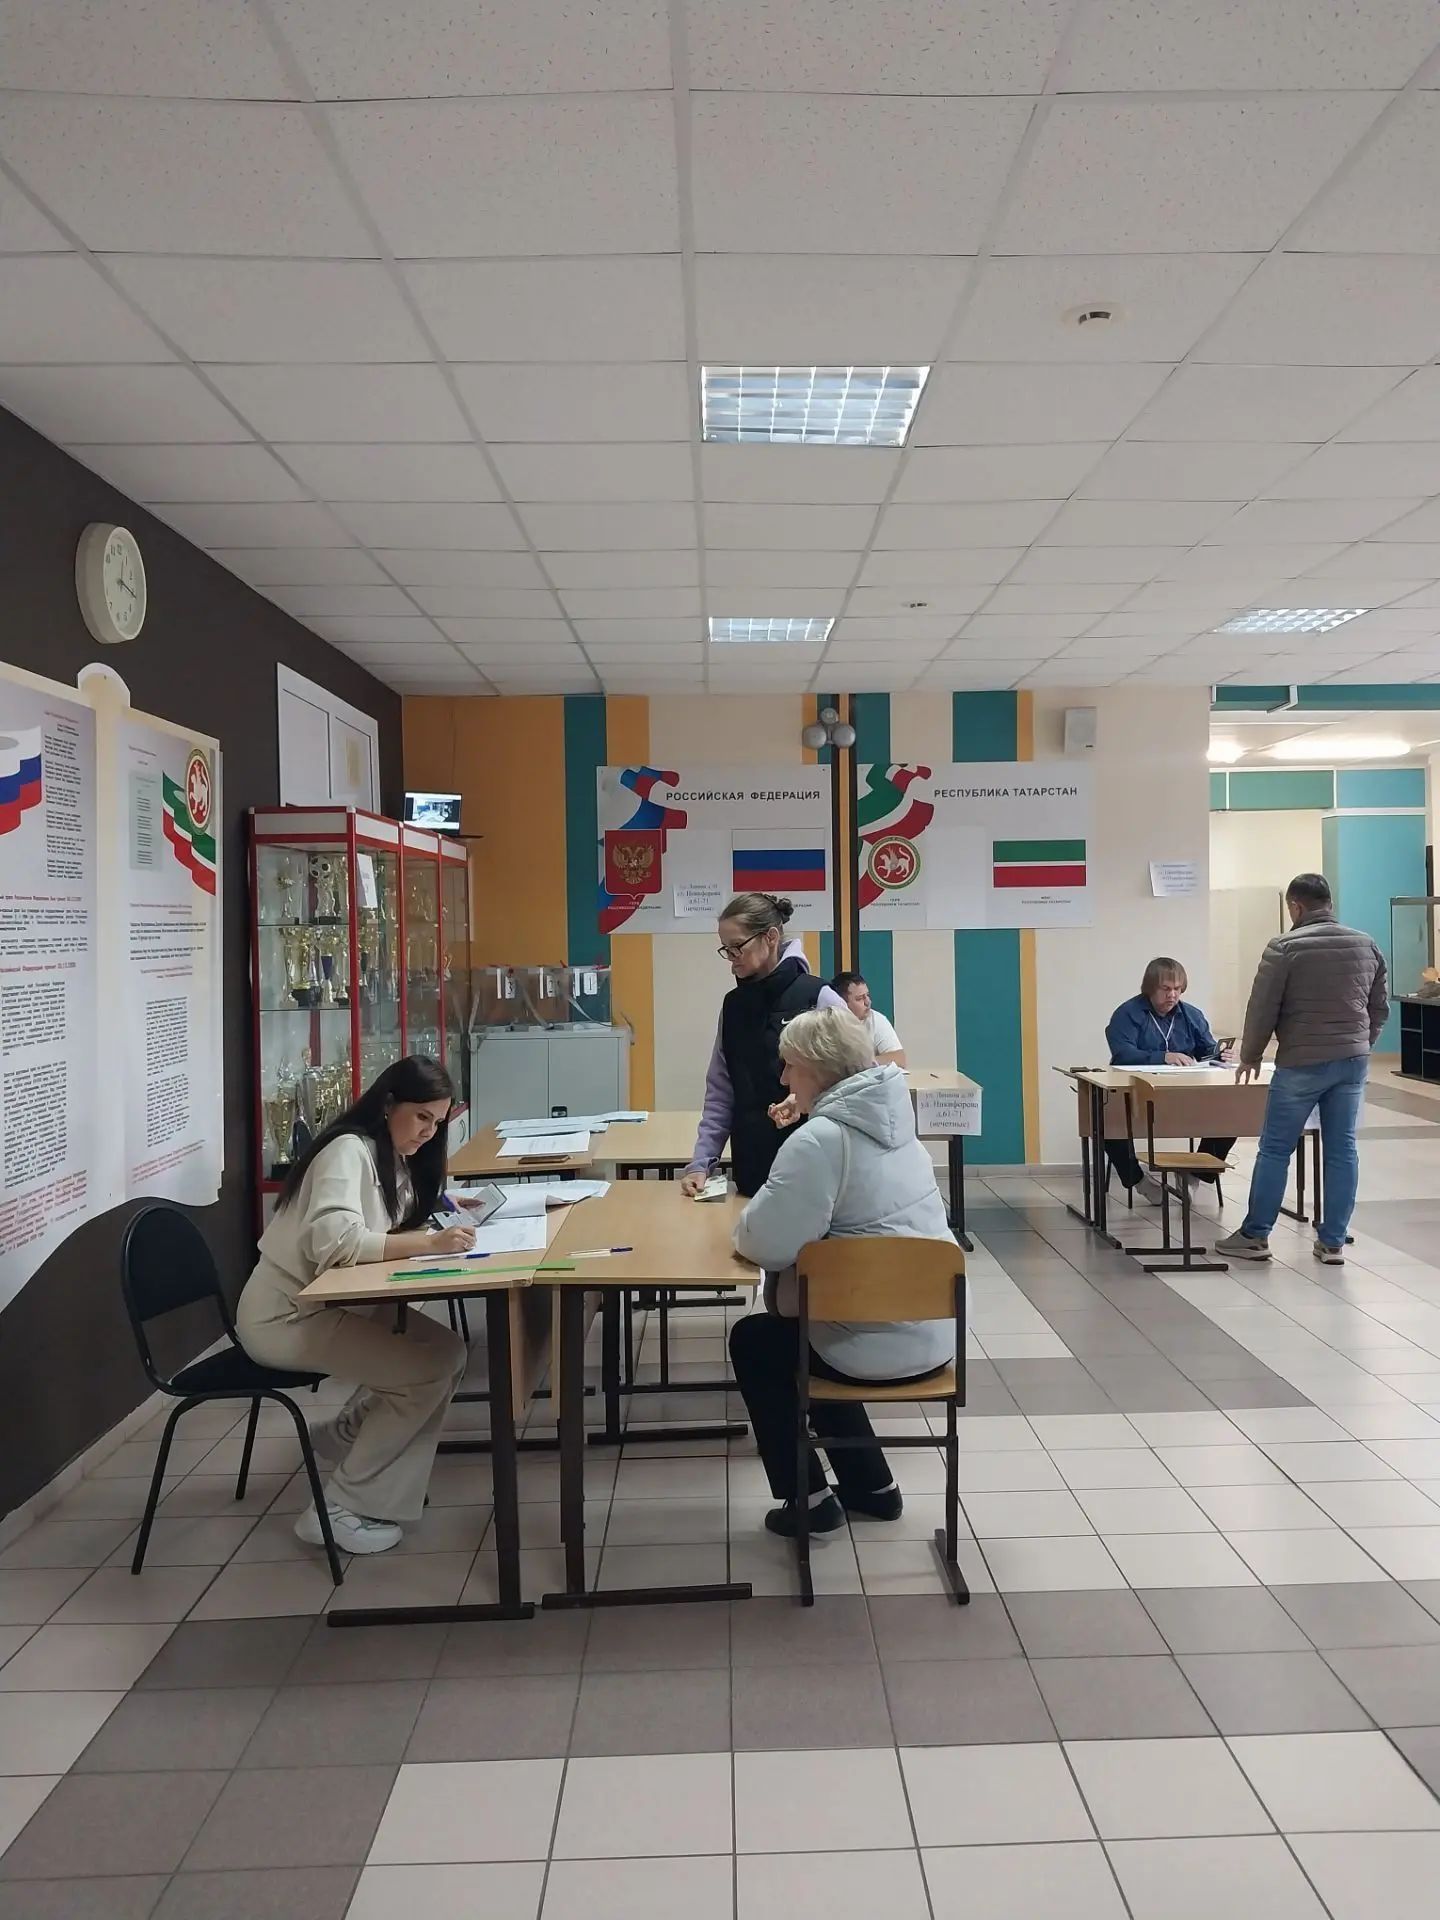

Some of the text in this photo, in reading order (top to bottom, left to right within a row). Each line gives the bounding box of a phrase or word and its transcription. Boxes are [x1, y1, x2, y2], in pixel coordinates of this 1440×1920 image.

[666, 790, 820, 801] РОССИЙСКАЯ ФЕДЕРАЦИЯ
[934, 787, 1078, 798] РЕСПУБЛИКА ТАТАРСТАН
